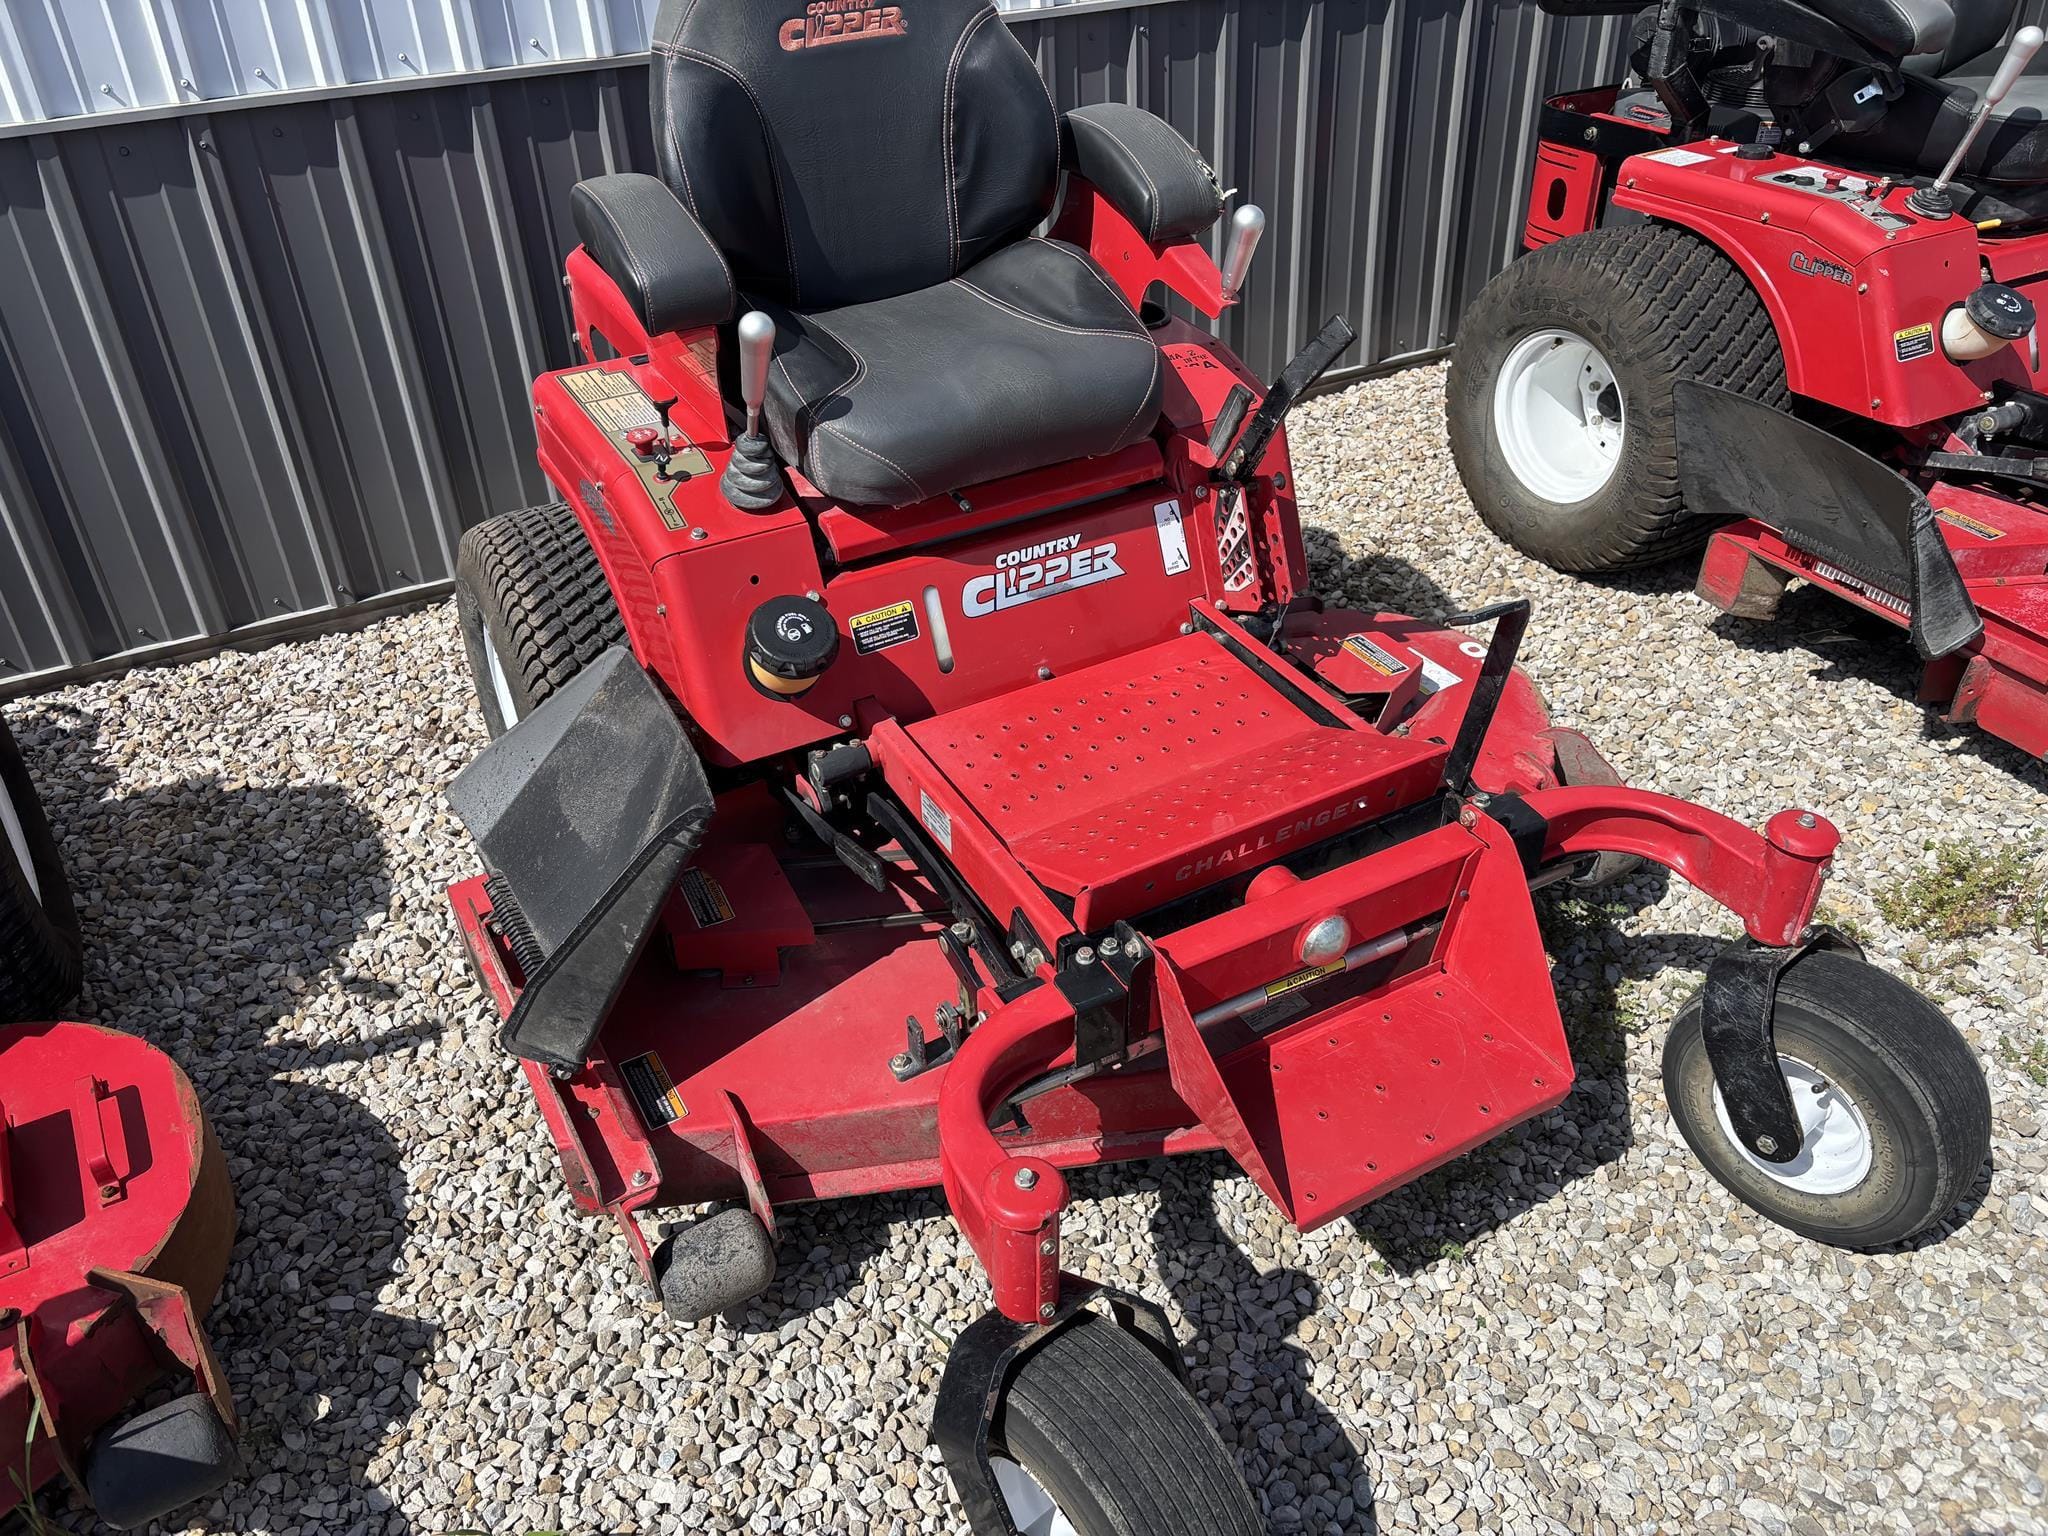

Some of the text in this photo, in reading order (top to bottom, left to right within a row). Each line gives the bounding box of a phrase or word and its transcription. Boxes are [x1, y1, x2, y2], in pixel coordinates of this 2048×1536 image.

[806, 0, 875, 15] COUNTRY
[778, 6, 907, 51] CLIPPER
[1789, 250, 1854, 287] CLIPPER
[994, 532, 1082, 570] COUNTRY
[961, 542, 1127, 619] CLIPPER
[865, 608, 897, 623] CAUTION
[1175, 795, 1369, 882] CHALLENGER
[1293, 967, 1326, 984] CAUTION
